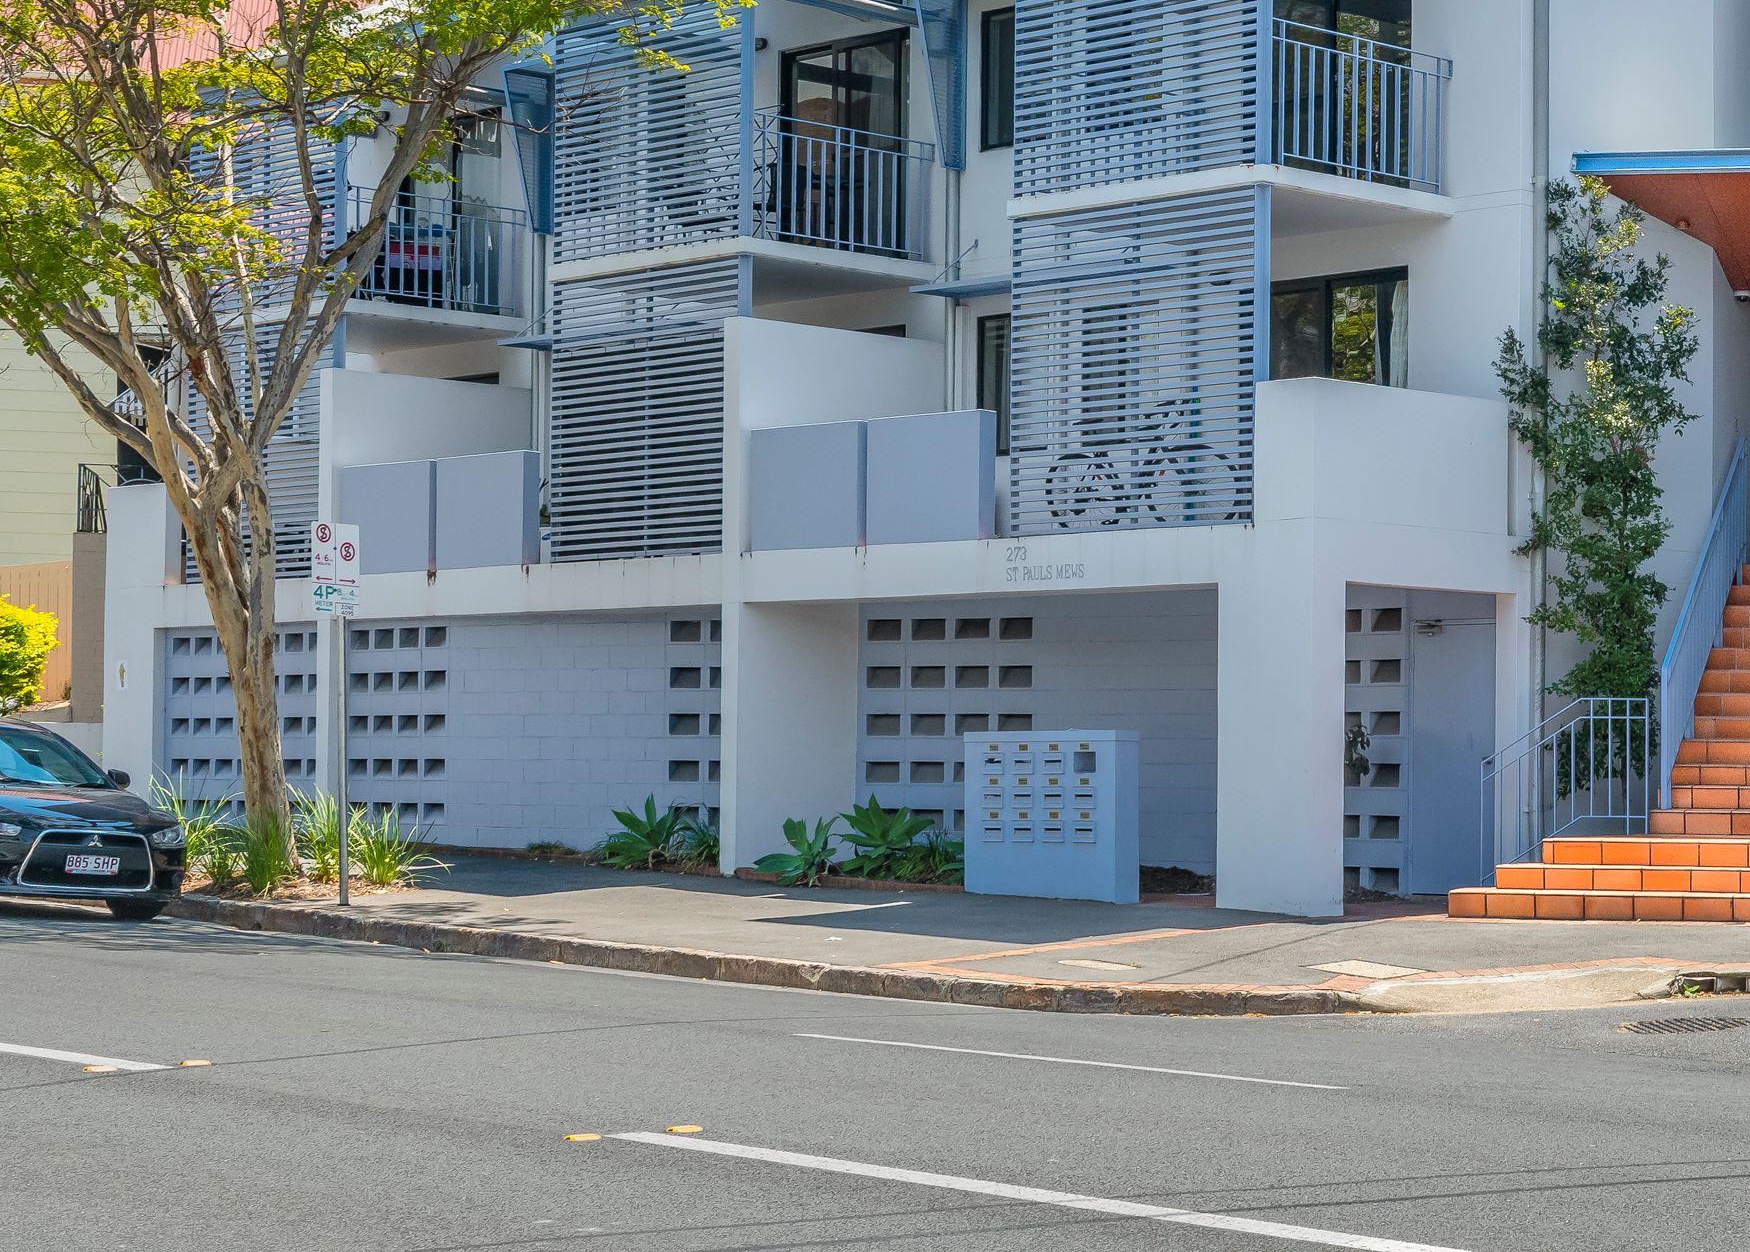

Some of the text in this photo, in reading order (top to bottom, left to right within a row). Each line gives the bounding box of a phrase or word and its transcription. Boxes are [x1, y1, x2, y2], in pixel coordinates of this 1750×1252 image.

[1006, 546, 1027, 562] 273
[1006, 563, 1085, 581] ST PAULS MEWS
[313, 584, 334, 599] 4P
[67, 856, 119, 869] 885 SHP
